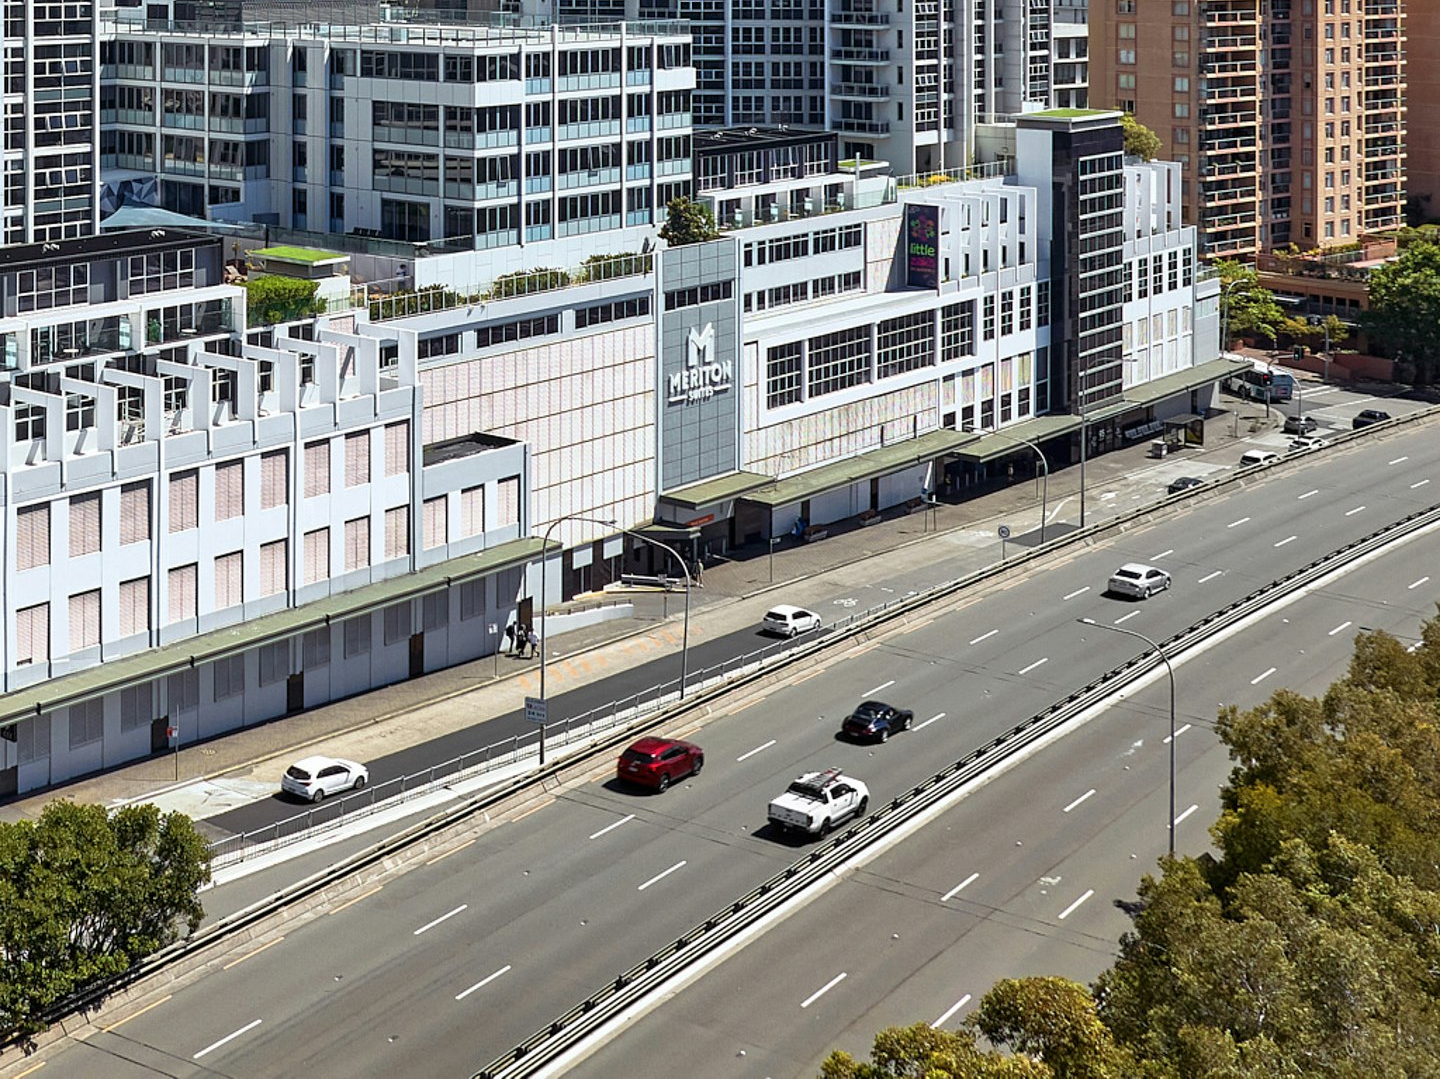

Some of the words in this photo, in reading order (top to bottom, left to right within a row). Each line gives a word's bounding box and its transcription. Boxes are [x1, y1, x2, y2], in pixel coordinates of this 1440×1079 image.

[910, 242, 936, 257] little
[668, 360, 733, 394] MERITON
[688, 385, 714, 401] SUITES
